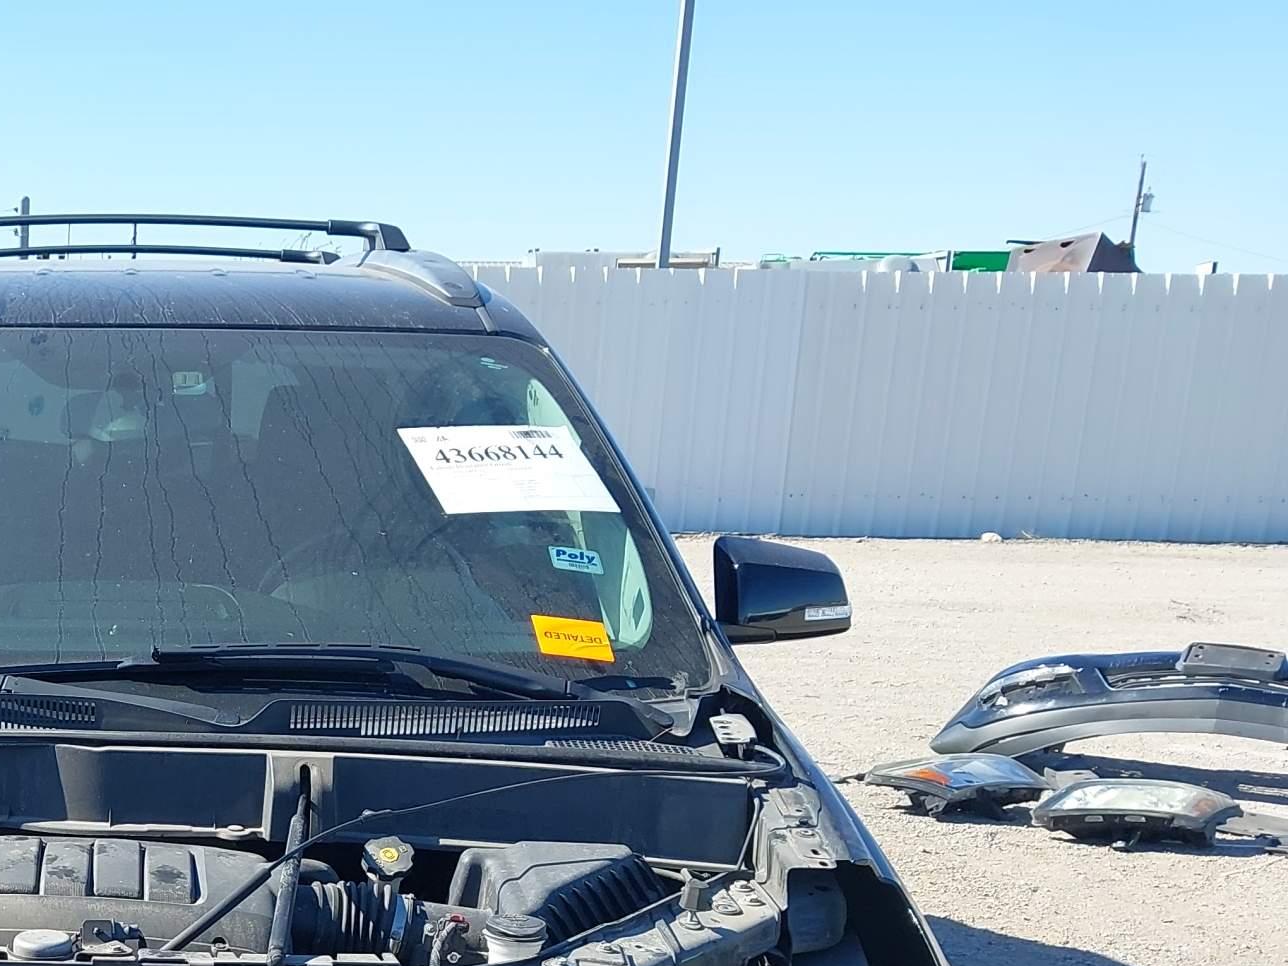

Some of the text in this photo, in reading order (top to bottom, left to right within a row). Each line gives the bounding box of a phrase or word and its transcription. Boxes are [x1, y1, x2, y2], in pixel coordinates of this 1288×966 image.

[435, 444, 564, 464] 43668144
[556, 549, 595, 564] Poly
[543, 630, 603, 645] DETAILED
